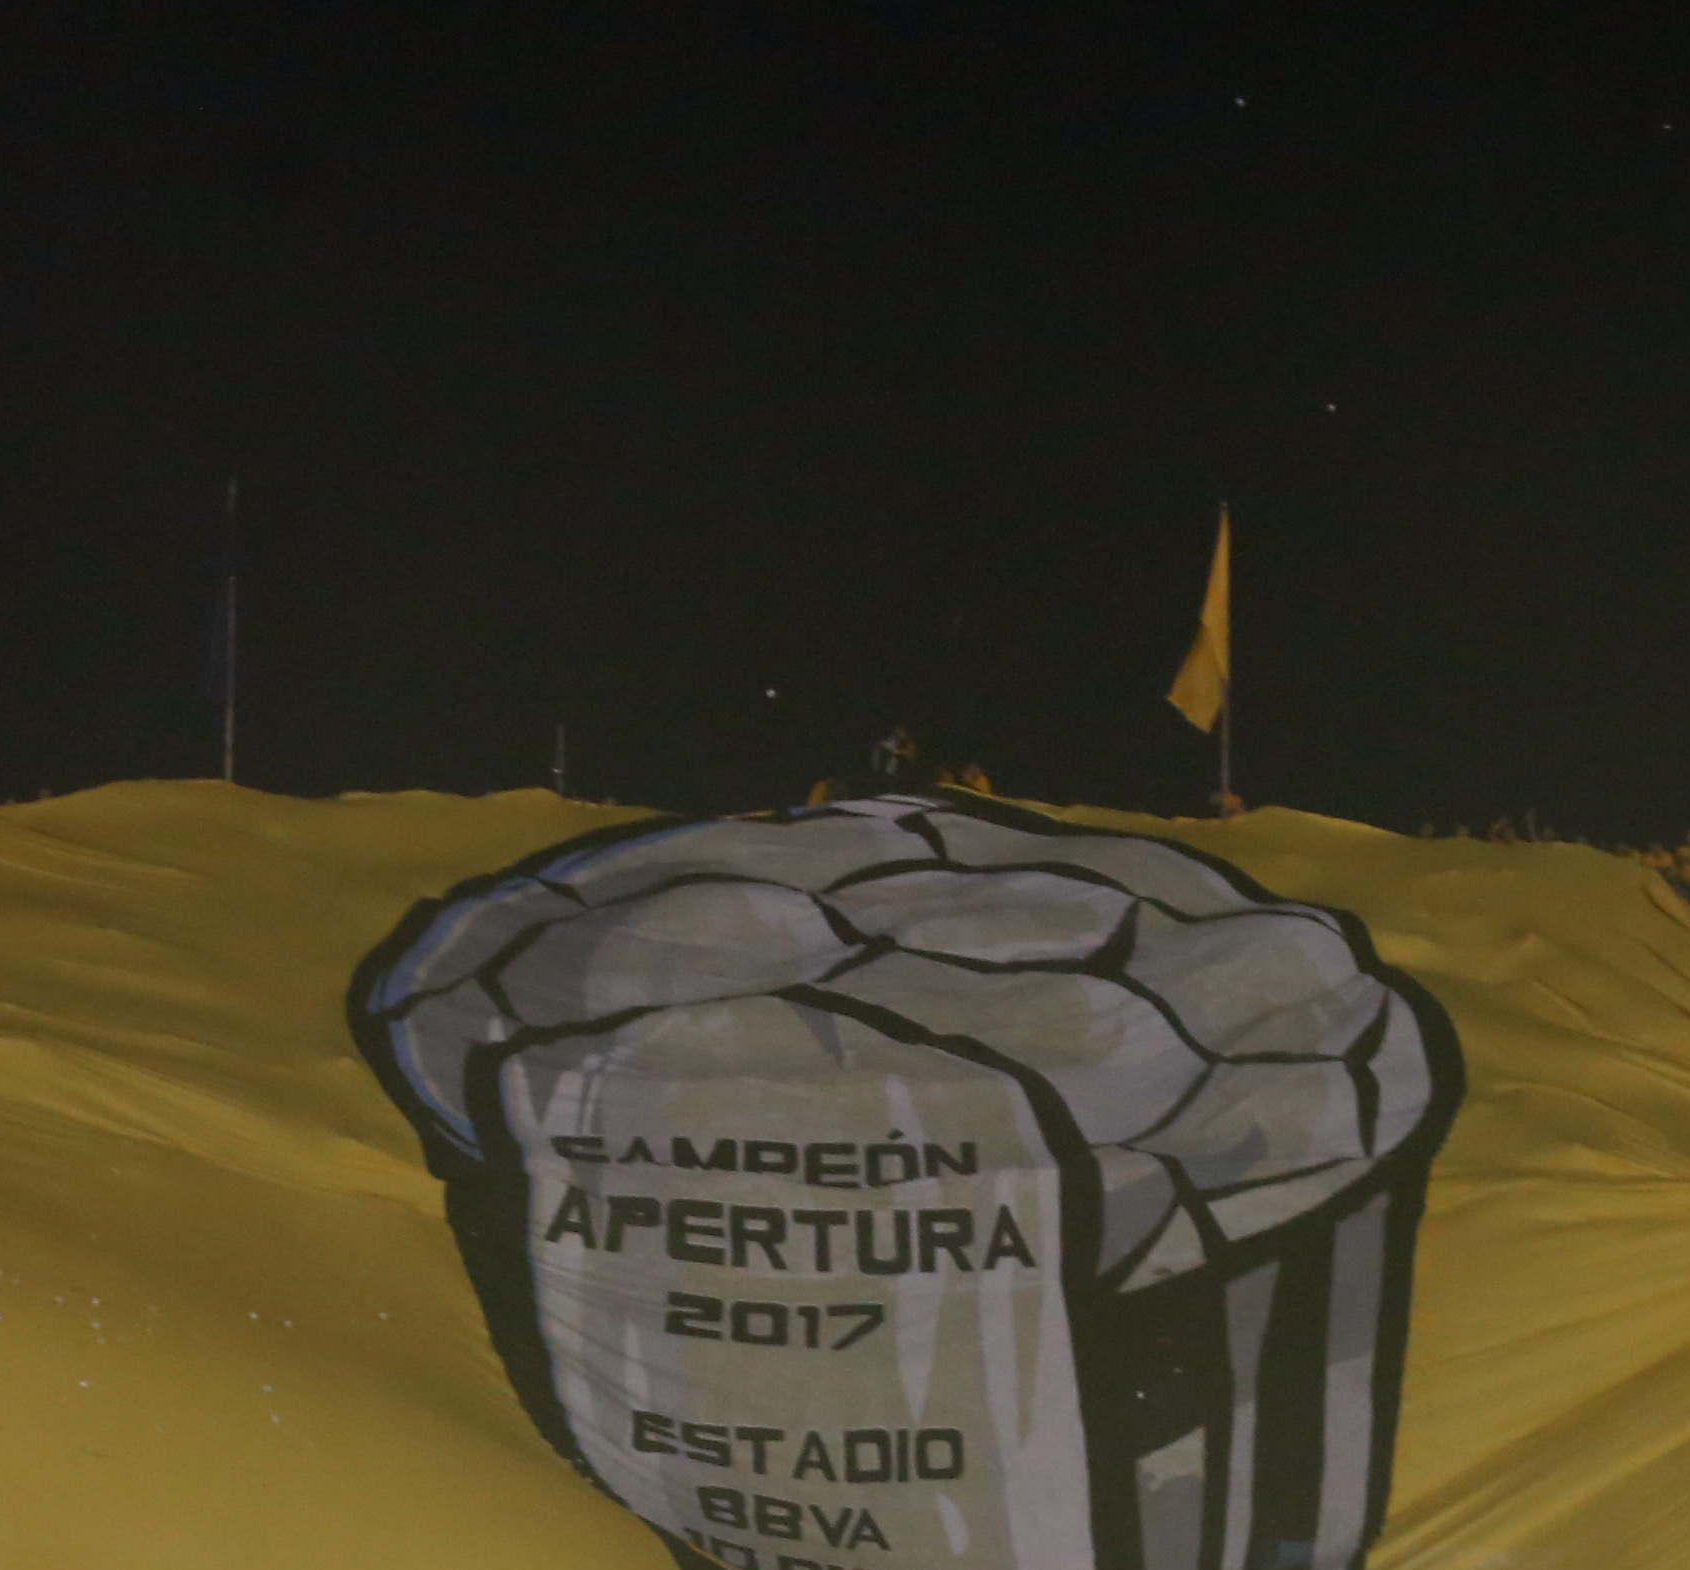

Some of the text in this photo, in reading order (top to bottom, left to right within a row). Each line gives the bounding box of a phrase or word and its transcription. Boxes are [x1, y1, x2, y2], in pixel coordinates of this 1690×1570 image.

[545, 1184, 1037, 1275] APERTURA
[664, 1291, 885, 1351] 2017
[632, 1409, 964, 1484] ESTADIO
[697, 1485, 892, 1551] BBVA
